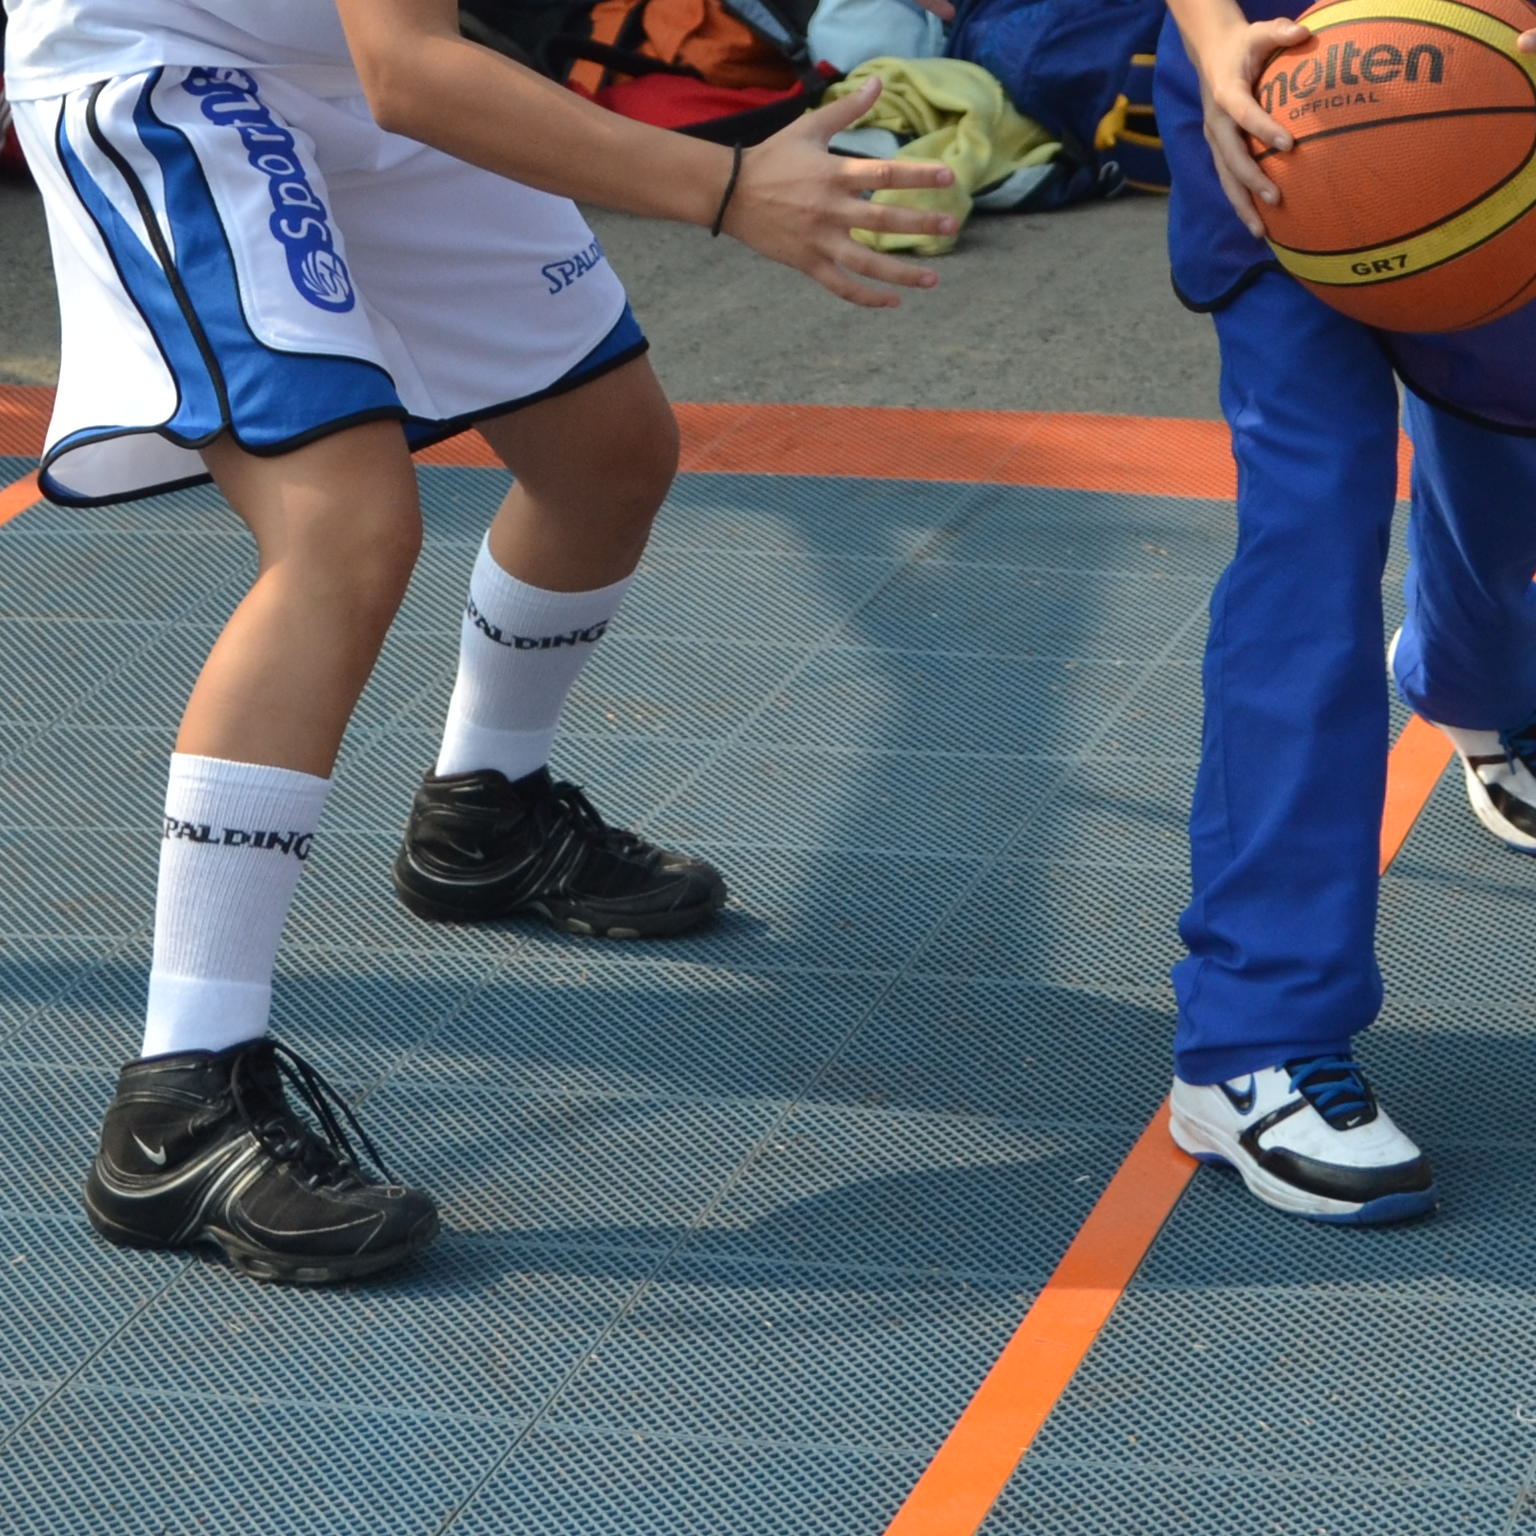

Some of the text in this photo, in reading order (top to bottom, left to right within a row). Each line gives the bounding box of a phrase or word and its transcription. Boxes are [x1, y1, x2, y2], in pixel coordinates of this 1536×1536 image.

[1260, 39, 1445, 114] molten
[1288, 90, 1380, 121] OFFICIAL
[1351, 253, 1409, 277] GR7
[466, 598, 610, 651] PALDING
[163, 815, 314, 862] PALDING
